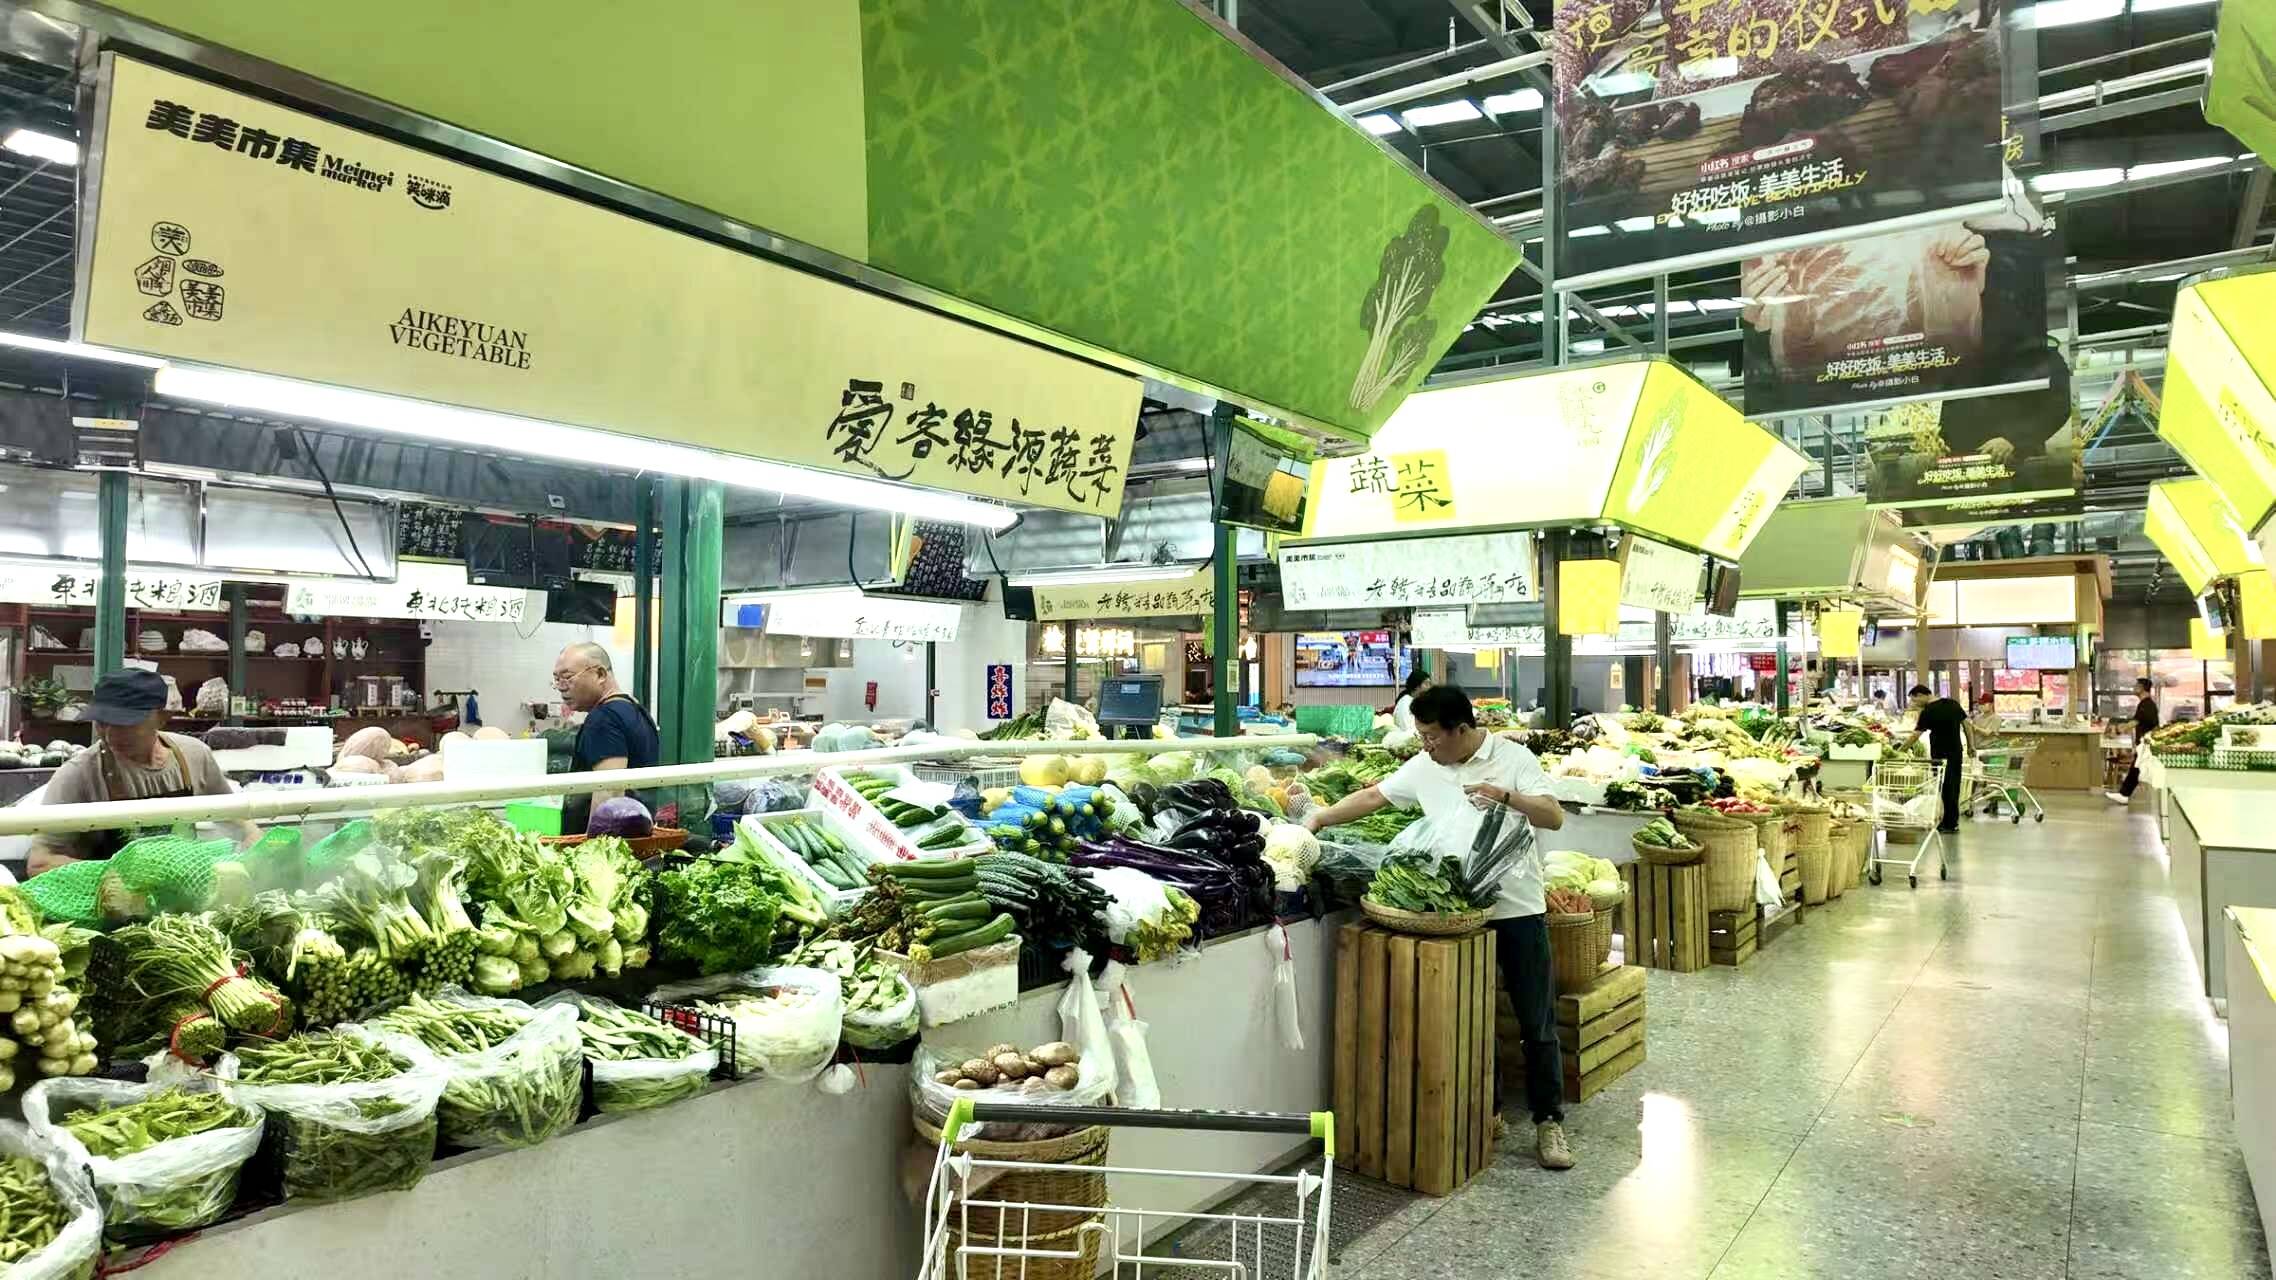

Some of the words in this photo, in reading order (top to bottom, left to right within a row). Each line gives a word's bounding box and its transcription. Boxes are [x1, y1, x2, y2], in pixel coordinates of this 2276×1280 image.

[146, 99, 321, 174] 美美市集
[320, 167, 384, 193] market
[323, 154, 395, 187] Meimei
[1701, 158, 1730, 172] 小红书
[388, 323, 533, 371] VEGETABLE
[397, 307, 528, 351] AIKEYUAN
[1348, 455, 1454, 512] 蔬菜
